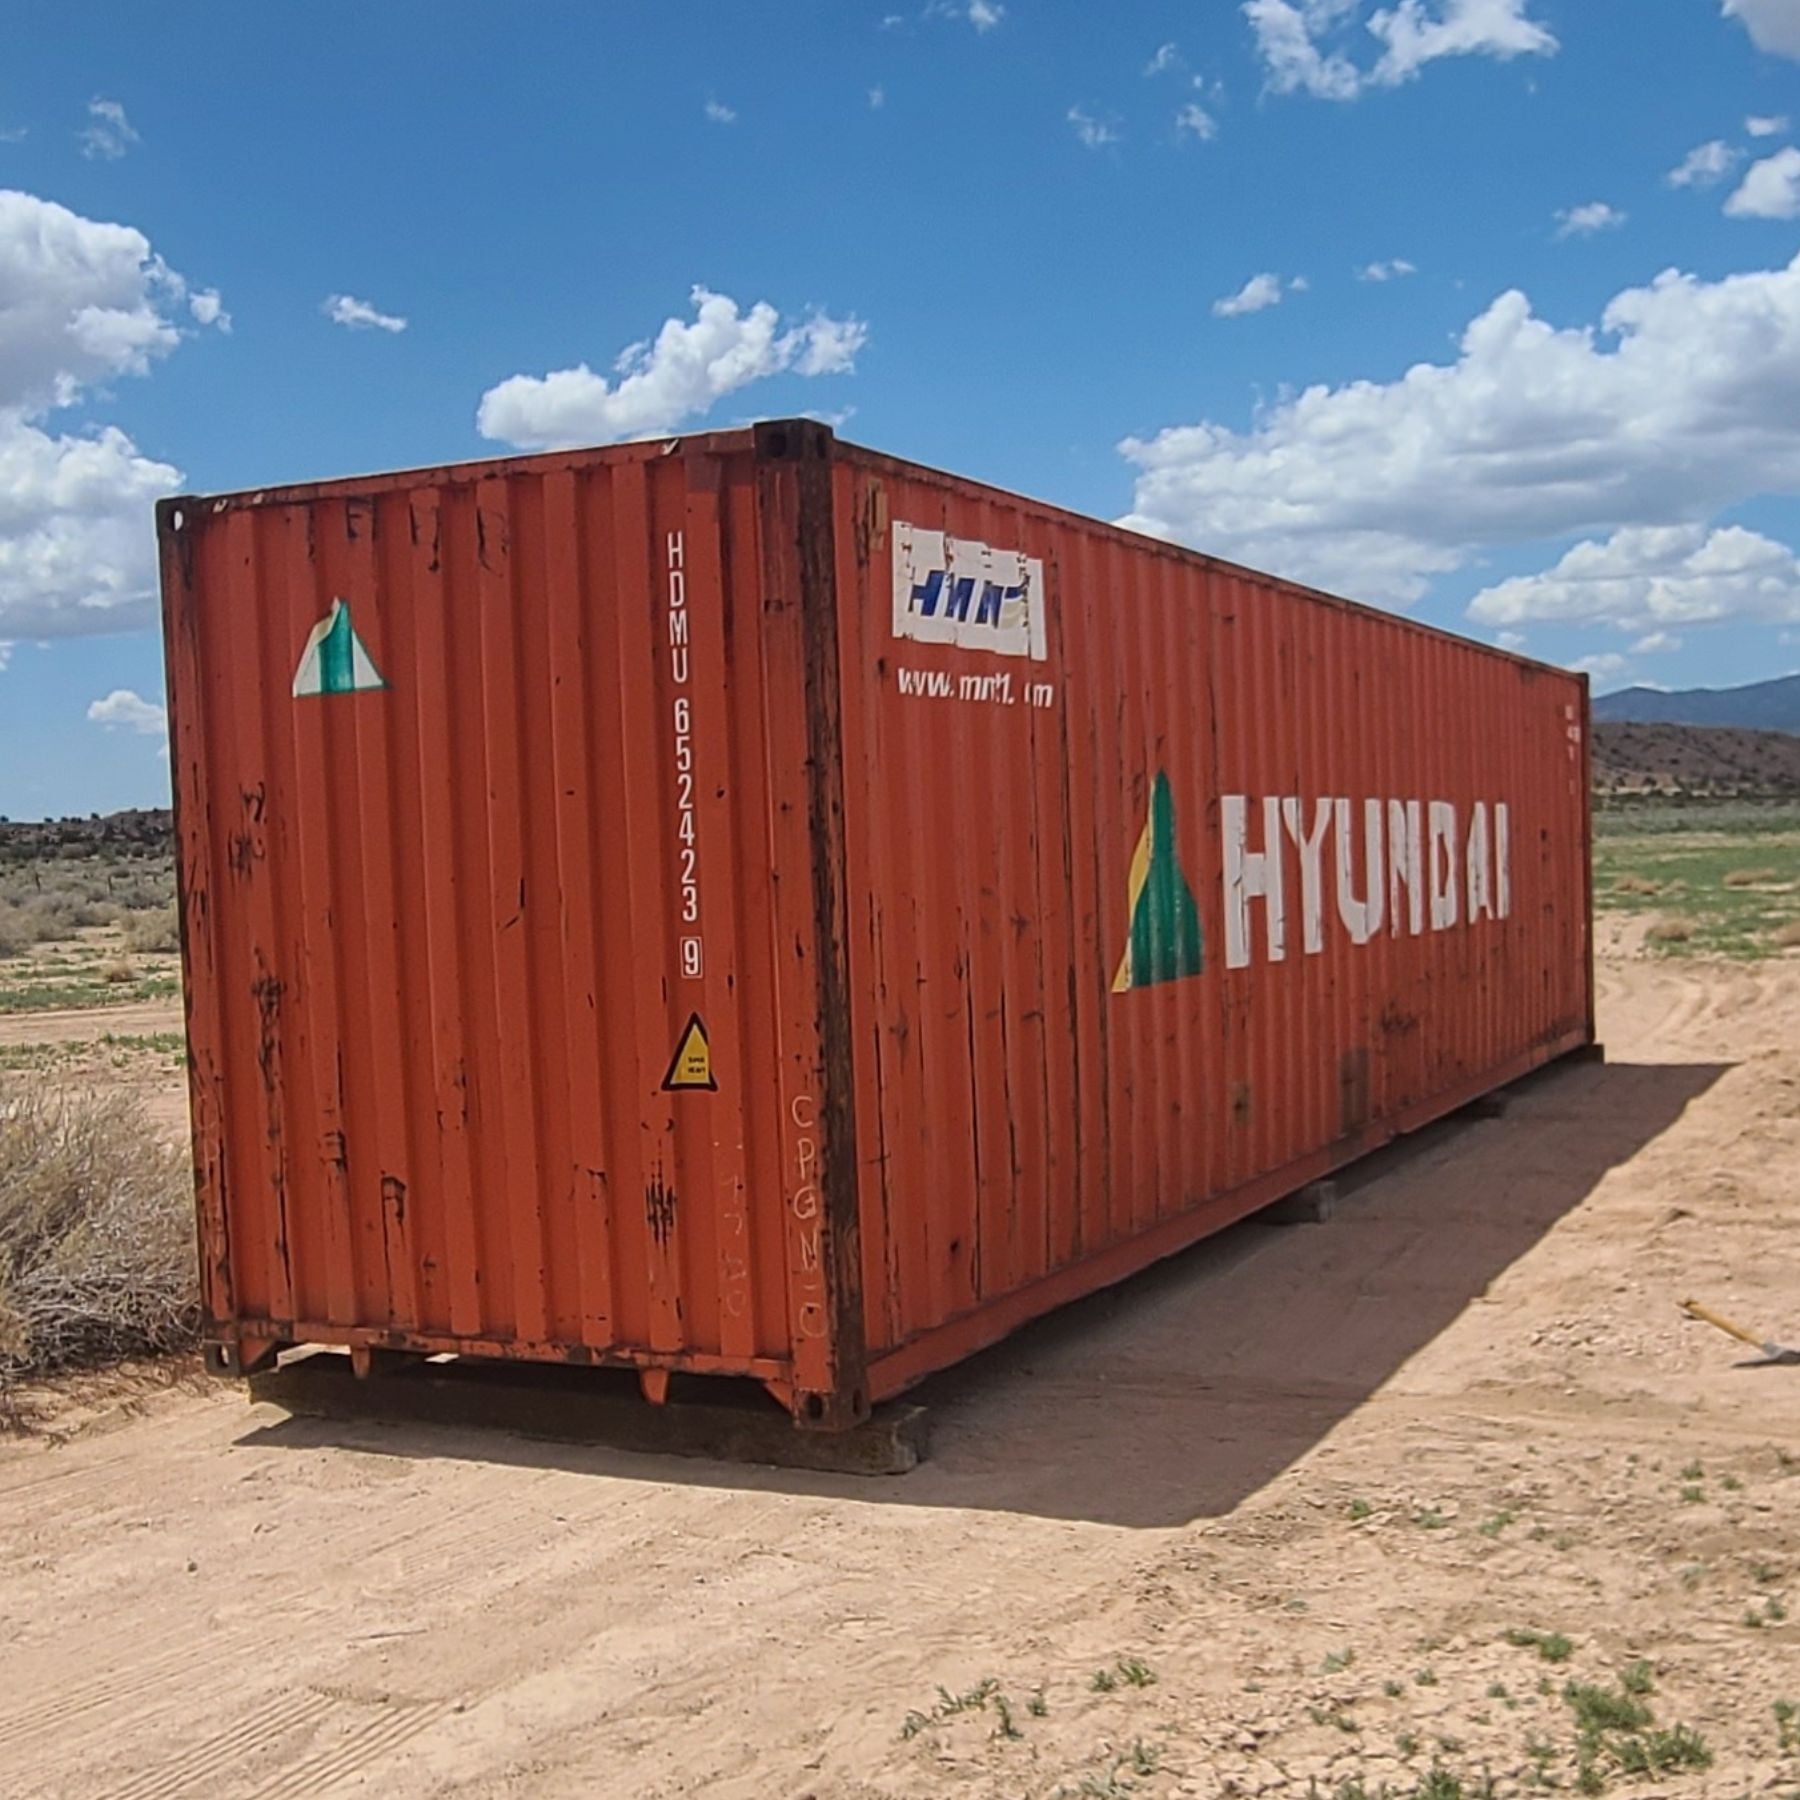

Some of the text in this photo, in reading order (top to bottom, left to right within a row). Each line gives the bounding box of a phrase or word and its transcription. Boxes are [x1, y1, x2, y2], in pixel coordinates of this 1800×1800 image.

[667, 530, 701, 977] HDMU 652423 9
[1221, 794, 1511, 969] HYUNDAI
